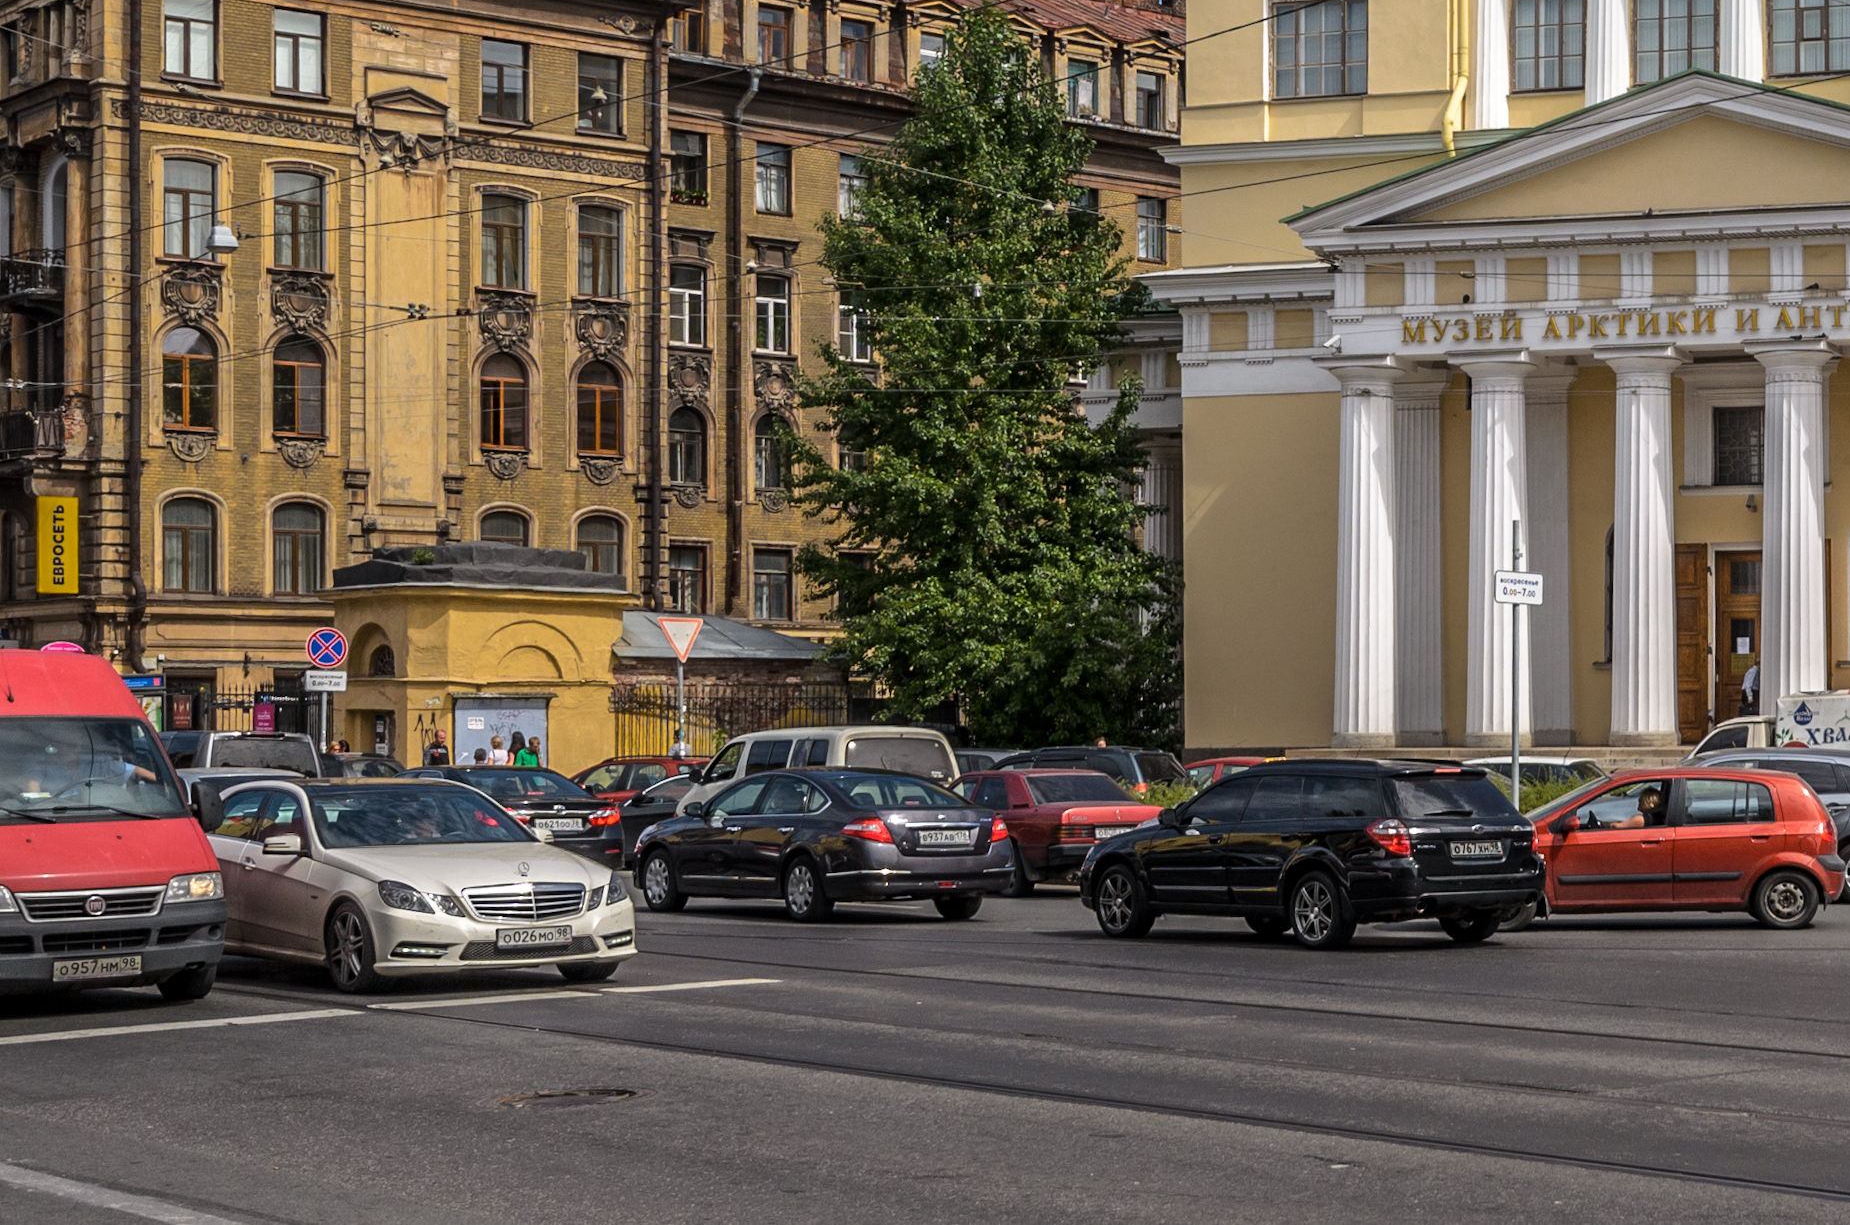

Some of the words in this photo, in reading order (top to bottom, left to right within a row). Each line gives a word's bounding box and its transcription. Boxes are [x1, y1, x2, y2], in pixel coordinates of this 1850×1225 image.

[1401, 312, 1523, 343] МУЗЕЙ
[1542, 310, 1716, 338] АРКТИКИ
[1735, 309, 1760, 330] И
[52, 504, 65, 586] ЕВРОСЕТЬ
[1500, 578, 1539, 586] воскресенье
[503, 930, 554, 944] О026МО
[556, 927, 568, 938] 98
[60, 960, 119, 975] О957НМ
[122, 957, 136, 968] 98
